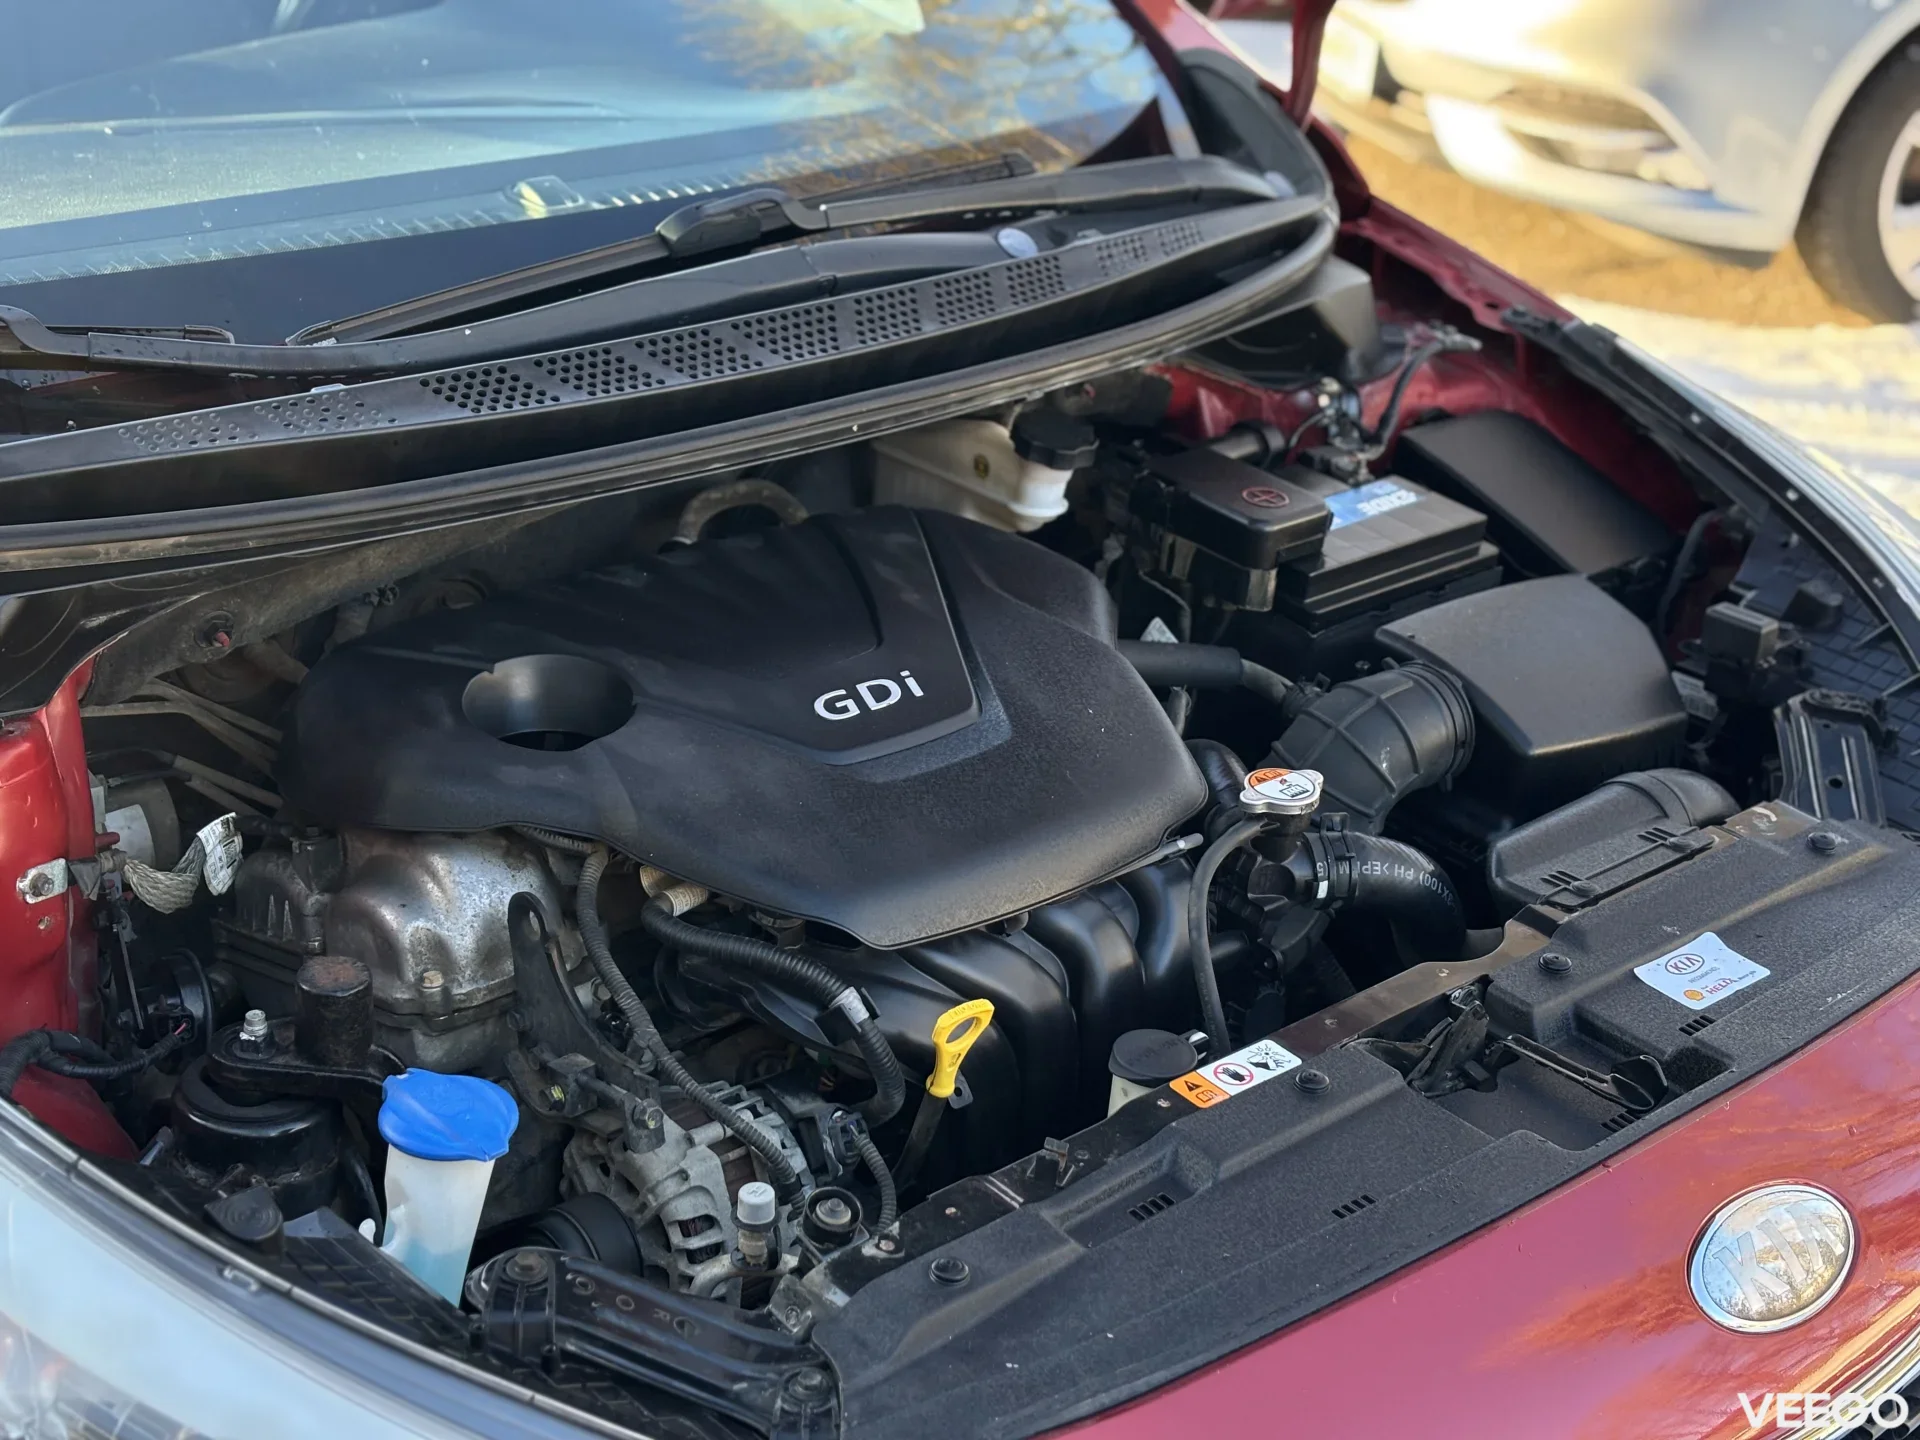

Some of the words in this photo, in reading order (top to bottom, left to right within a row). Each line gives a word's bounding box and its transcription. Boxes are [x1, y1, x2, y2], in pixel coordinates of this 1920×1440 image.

[813, 669, 924, 721] GDi
[1394, 863, 1414, 880] PH
[1669, 956, 1702, 973] KIA
[1705, 977, 1738, 995] HELIX
[1711, 1202, 1845, 1312] KIA
